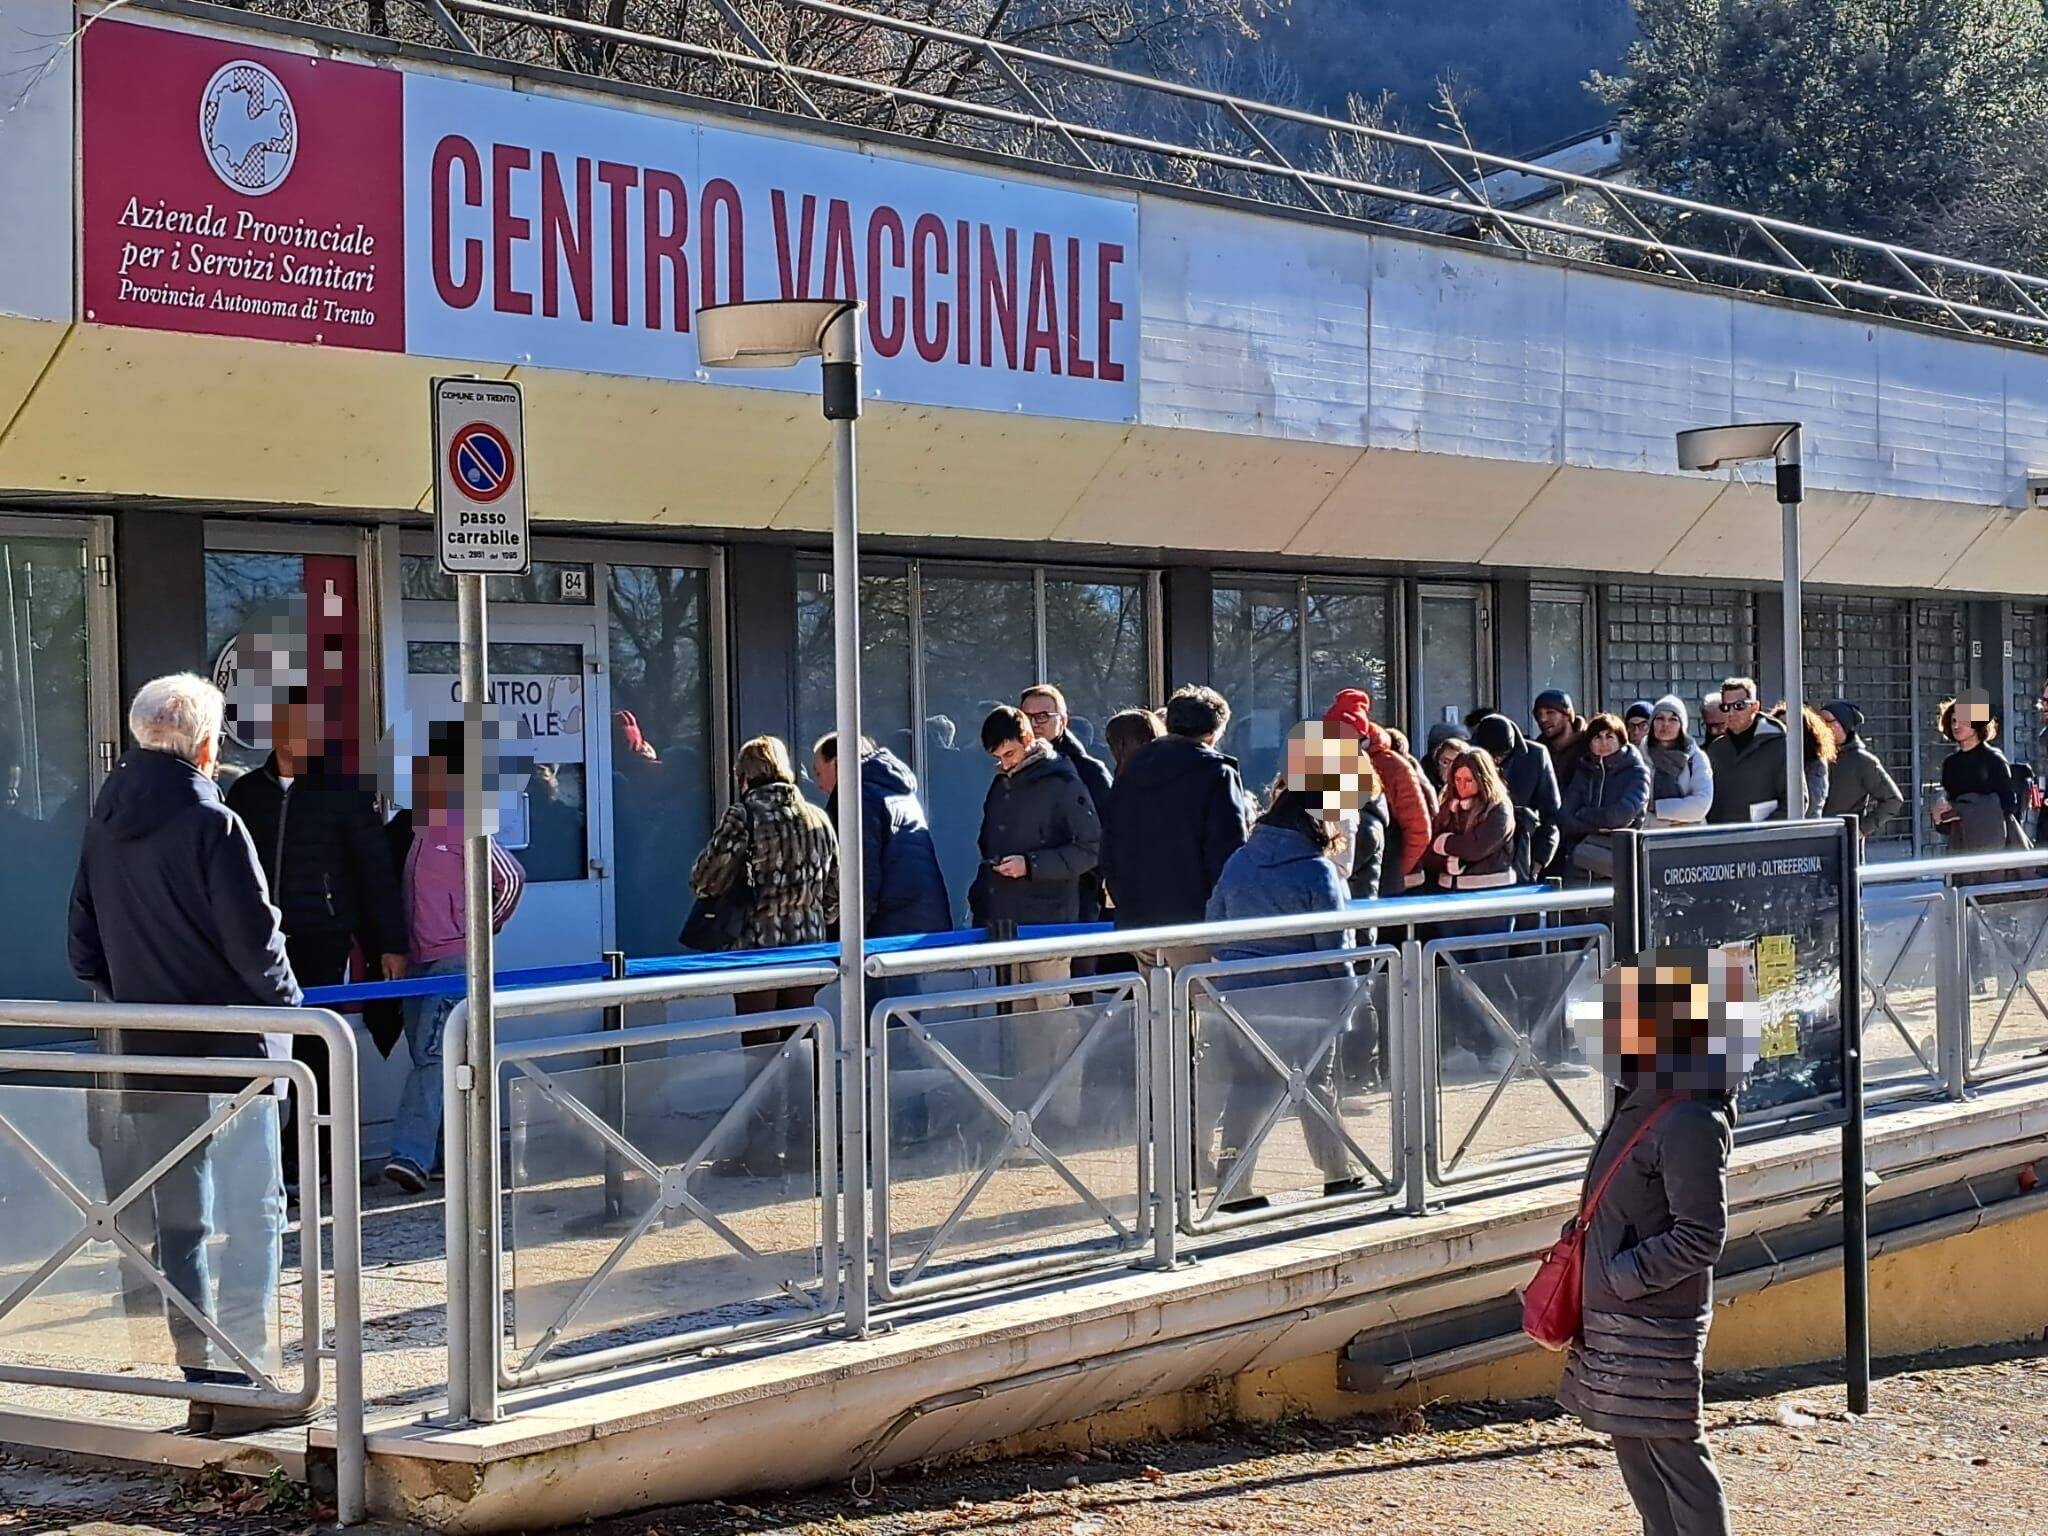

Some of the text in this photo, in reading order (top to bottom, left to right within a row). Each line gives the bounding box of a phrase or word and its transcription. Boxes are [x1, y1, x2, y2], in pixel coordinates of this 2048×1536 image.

[117, 196, 375, 256] Azienda Provinciale
[118, 241, 375, 293] per i Servizi Sanitari
[431, 134, 1125, 382] CENTRO VACCINALE
[118, 279, 375, 326] Provincia Autonoma di Trento
[441, 391, 516, 403] COMUNE DI TRENTO
[460, 512, 506, 527] passo
[447, 529, 519, 545] carrabile
[566, 573, 581, 589] 84
[1664, 863, 1735, 886] CIRCOSCRIZIONE
[1762, 856, 1822, 877] OLTREFERSINA
